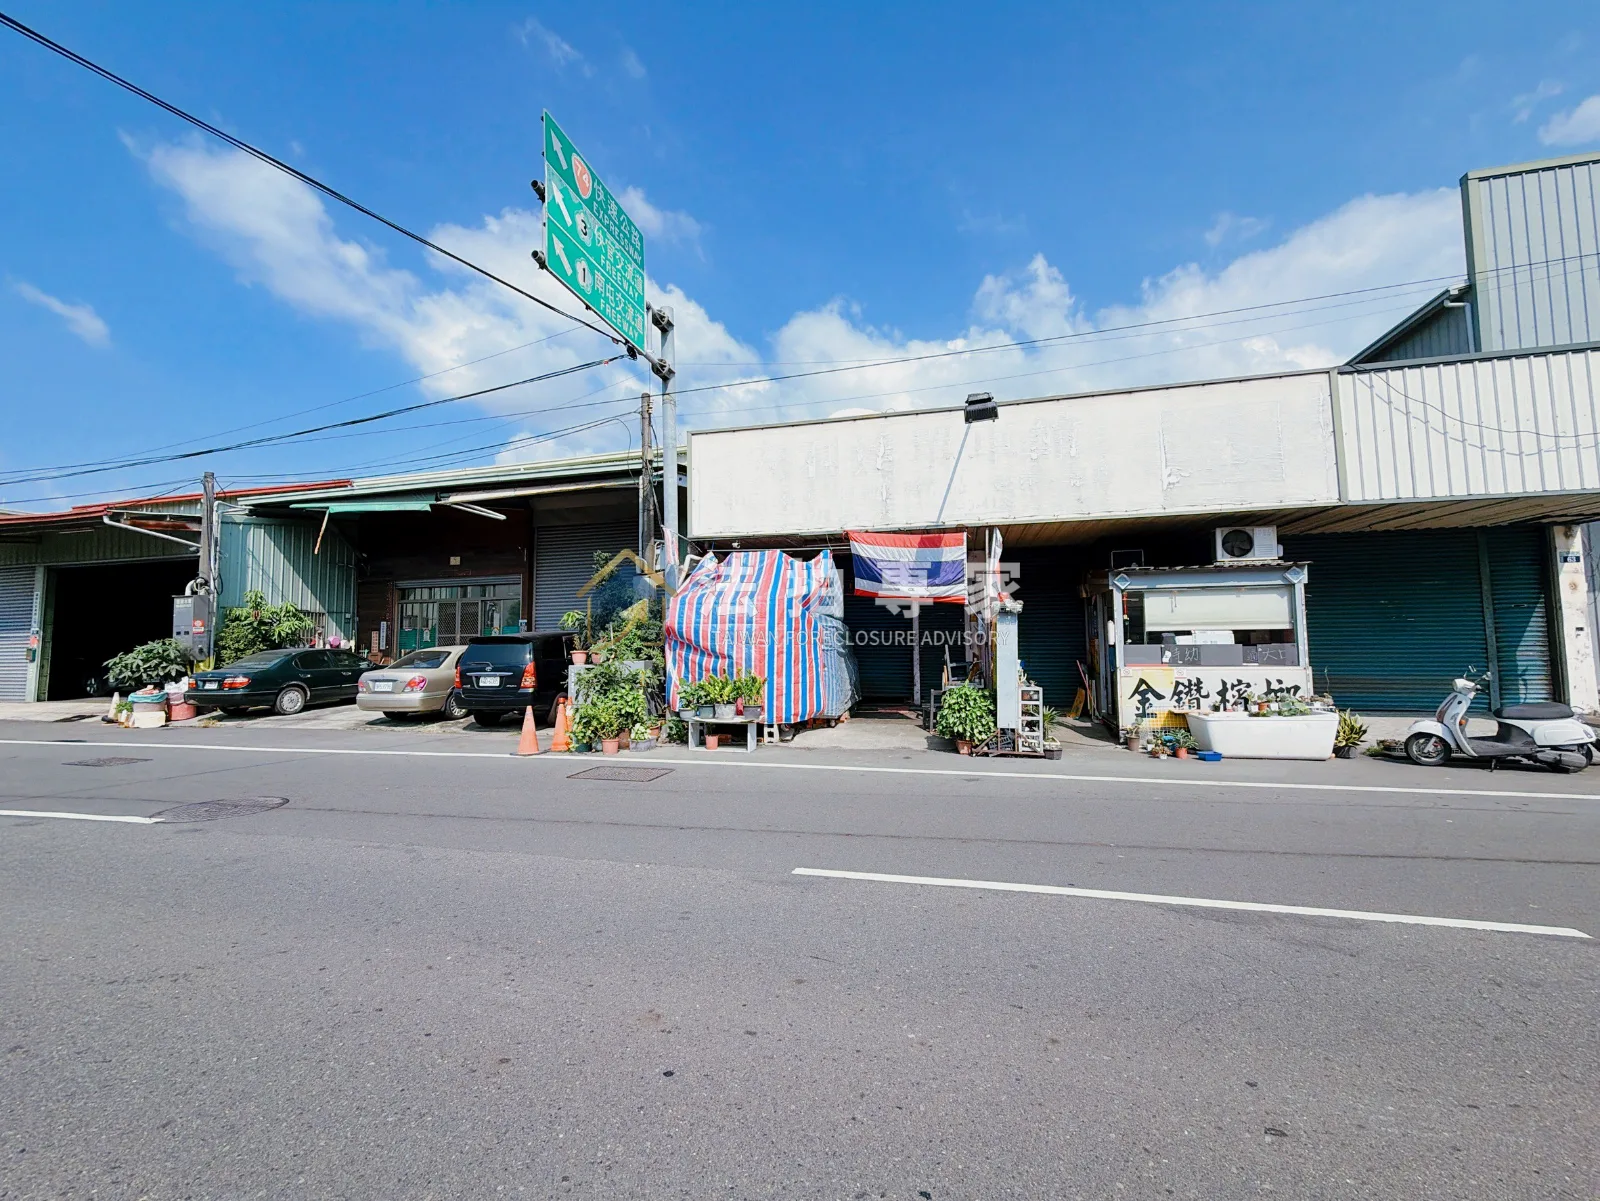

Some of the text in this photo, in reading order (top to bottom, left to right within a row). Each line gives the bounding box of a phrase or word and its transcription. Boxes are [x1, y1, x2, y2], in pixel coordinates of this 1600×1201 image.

[576, 163, 589, 187] 74
[581, 219, 587, 237] 3
[593, 179, 641, 251] 快速公路
[593, 201, 642, 266] EXPRESSWAY
[594, 269, 643, 334] 南屯交流道
[600, 254, 639, 302] FREEWAY
[600, 298, 639, 341] FREEWAY
